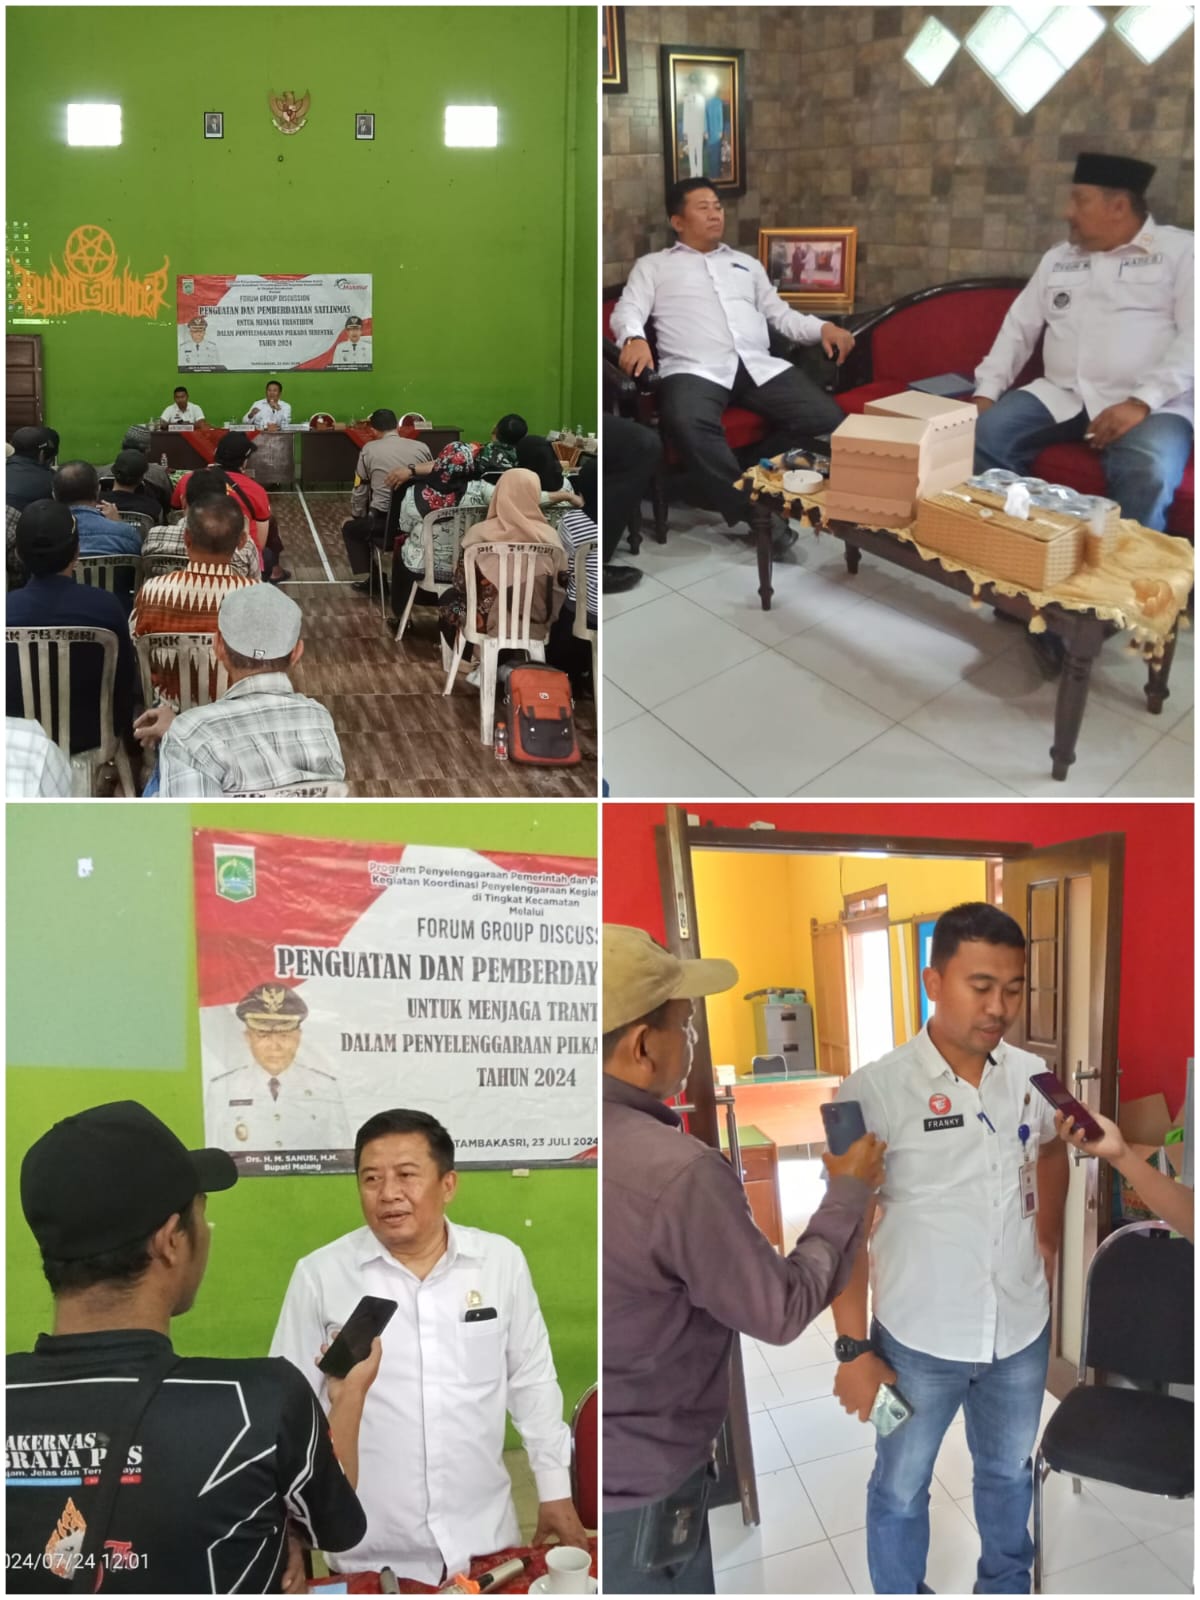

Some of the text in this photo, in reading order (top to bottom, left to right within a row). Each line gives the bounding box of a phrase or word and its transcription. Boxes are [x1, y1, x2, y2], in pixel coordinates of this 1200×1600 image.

[200, 304, 351, 315] PENGUATAN DAN PEMBERDAYAAN SATLINMAS
[278, 339, 293, 347] 2024
[370, 862, 416, 875] Program
[419, 866, 508, 880] Penyelenggaraan
[511, 871, 568, 883] Pemerintah
[570, 874, 588, 884] dan
[372, 875, 420, 886] Kegiatan
[423, 878, 479, 889] Koordinasi
[481, 881, 567, 895] Penyelenggaraan
[472, 893, 580, 907] di Tingkat Kecamatan
[509, 906, 544, 916] Melalui
[417, 917, 475, 940] FORUM
[481, 920, 534, 942] GROUP
[276, 947, 412, 980] PENGUATAN
[419, 953, 464, 982] DAN
[407, 997, 462, 1019] UNTUK
[468, 999, 542, 1023] MENJAGA
[340, 1032, 397, 1053] DALAM
[402, 1034, 552, 1054] PENYELENGGARAAN
[476, 1067, 576, 1087] TAHUN 2024
[928, 1118, 960, 1129] FRANKY
[454, 1137, 597, 1149] TAMBAKASRI, 23 JULI 2024
[245, 1155, 262, 1164] Drs.
[264, 1162, 322, 1172] Bupati Malang
[30, 1469, 57, 1477] Jelas
[60, 1468, 80, 1476] dan
